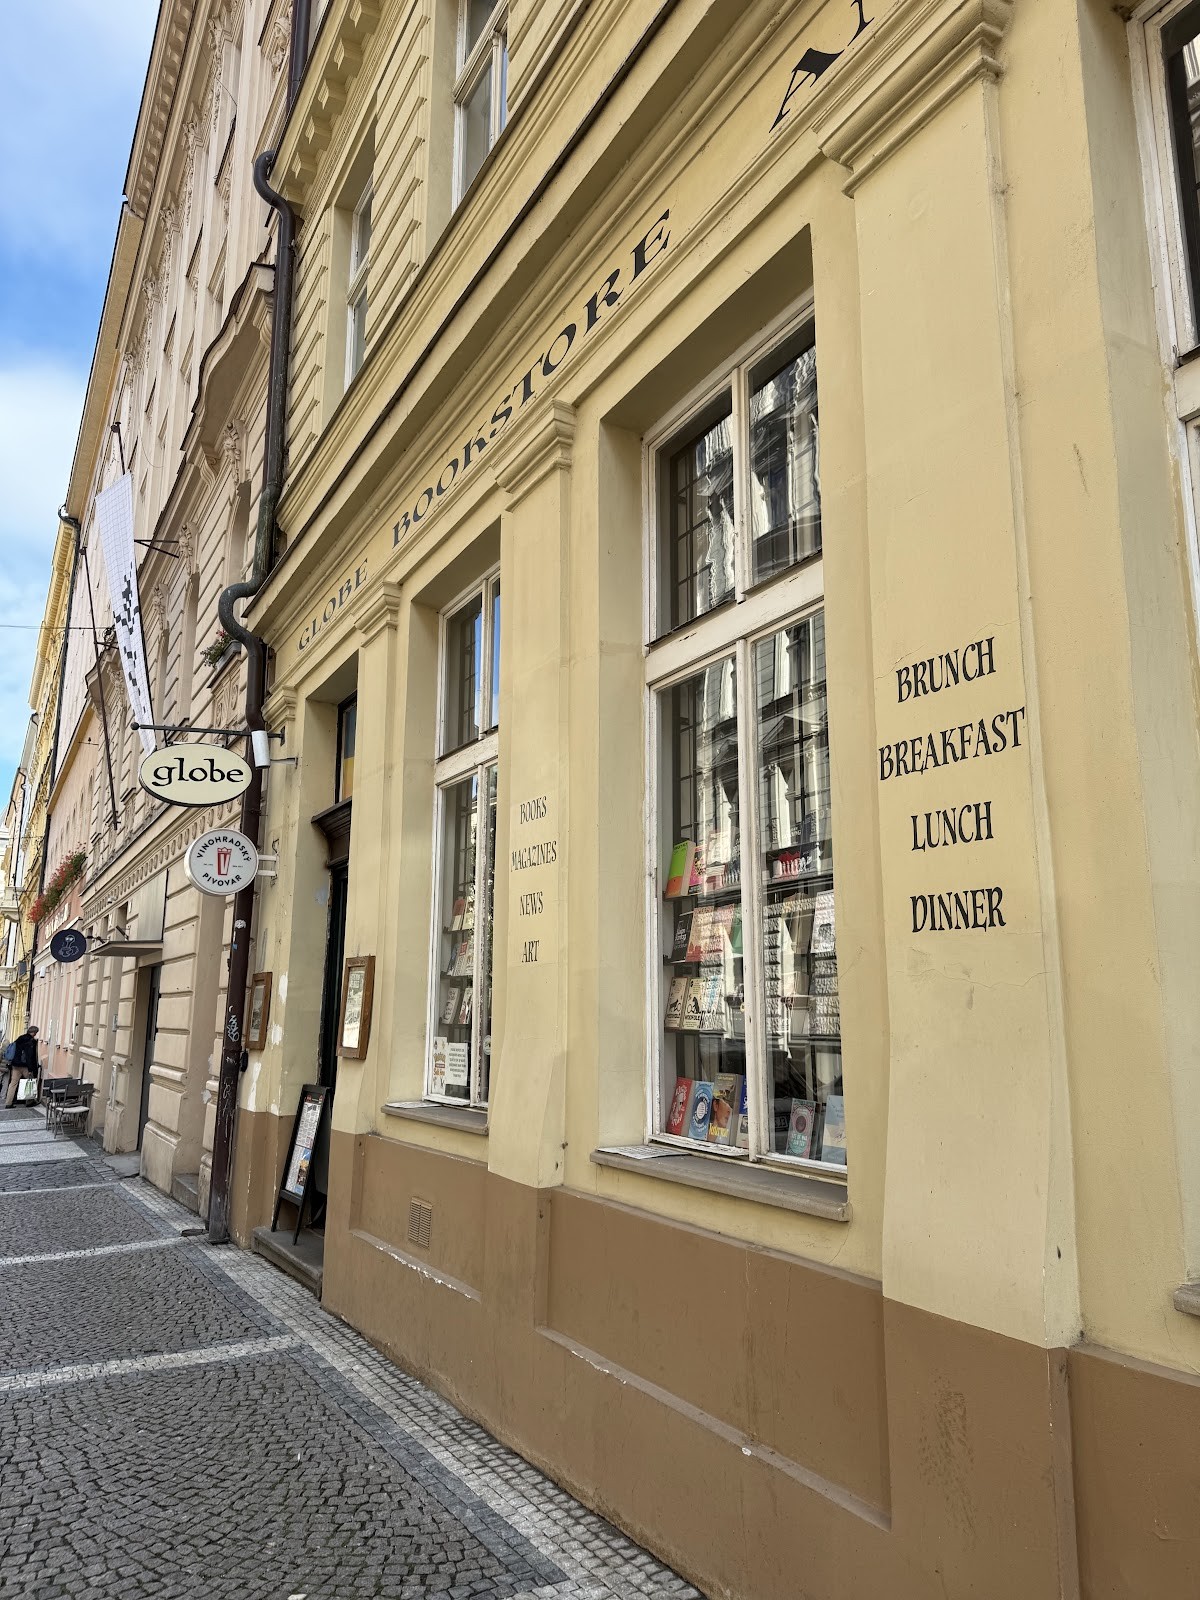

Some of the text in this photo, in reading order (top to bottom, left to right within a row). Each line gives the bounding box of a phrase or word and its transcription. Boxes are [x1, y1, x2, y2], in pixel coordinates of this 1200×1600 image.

[296, 557, 370, 652] GLOBE
[391, 208, 672, 550] BOOKSTORE
[895, 636, 996, 703] BRUNCH
[878, 706, 1026, 781] BREAKFAST
[151, 757, 244, 787] globe
[519, 795, 547, 824] BOOKS
[910, 801, 994, 852] LUNCH
[196, 835, 252, 862] VINOHRADSKÝ
[510, 840, 557, 872] MAGAZINES
[202, 872, 242, 887] PIVOVAR
[519, 891, 544, 916] NEWS
[910, 886, 1007, 933] DINNER
[521, 939, 539, 963] ART
